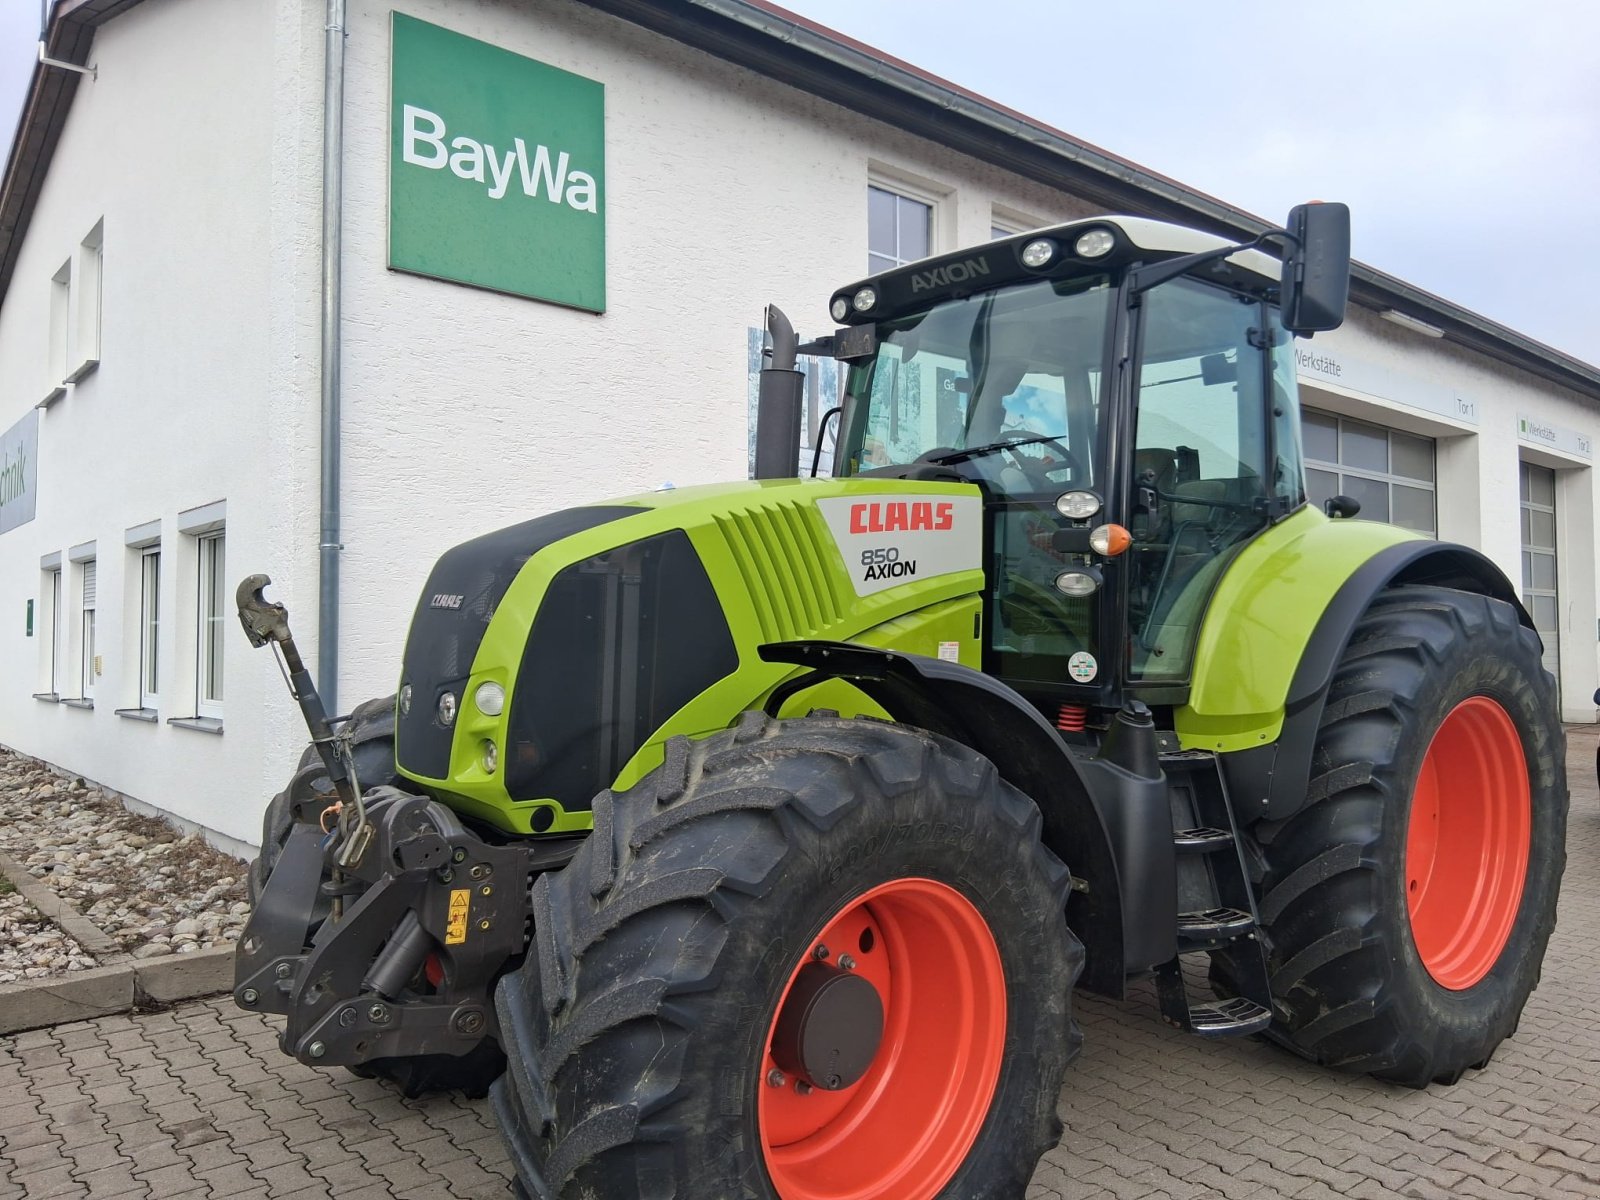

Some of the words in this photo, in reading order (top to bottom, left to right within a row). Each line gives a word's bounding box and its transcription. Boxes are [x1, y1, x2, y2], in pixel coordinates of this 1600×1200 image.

[403, 104, 597, 213] BayWa
[911, 256, 991, 293] AXION
[1457, 398, 1469, 415] Tor
[850, 502, 953, 534] CLAAS
[861, 547, 899, 566] 850
[864, 560, 917, 582] AXION
[431, 593, 464, 608] CLAAS
